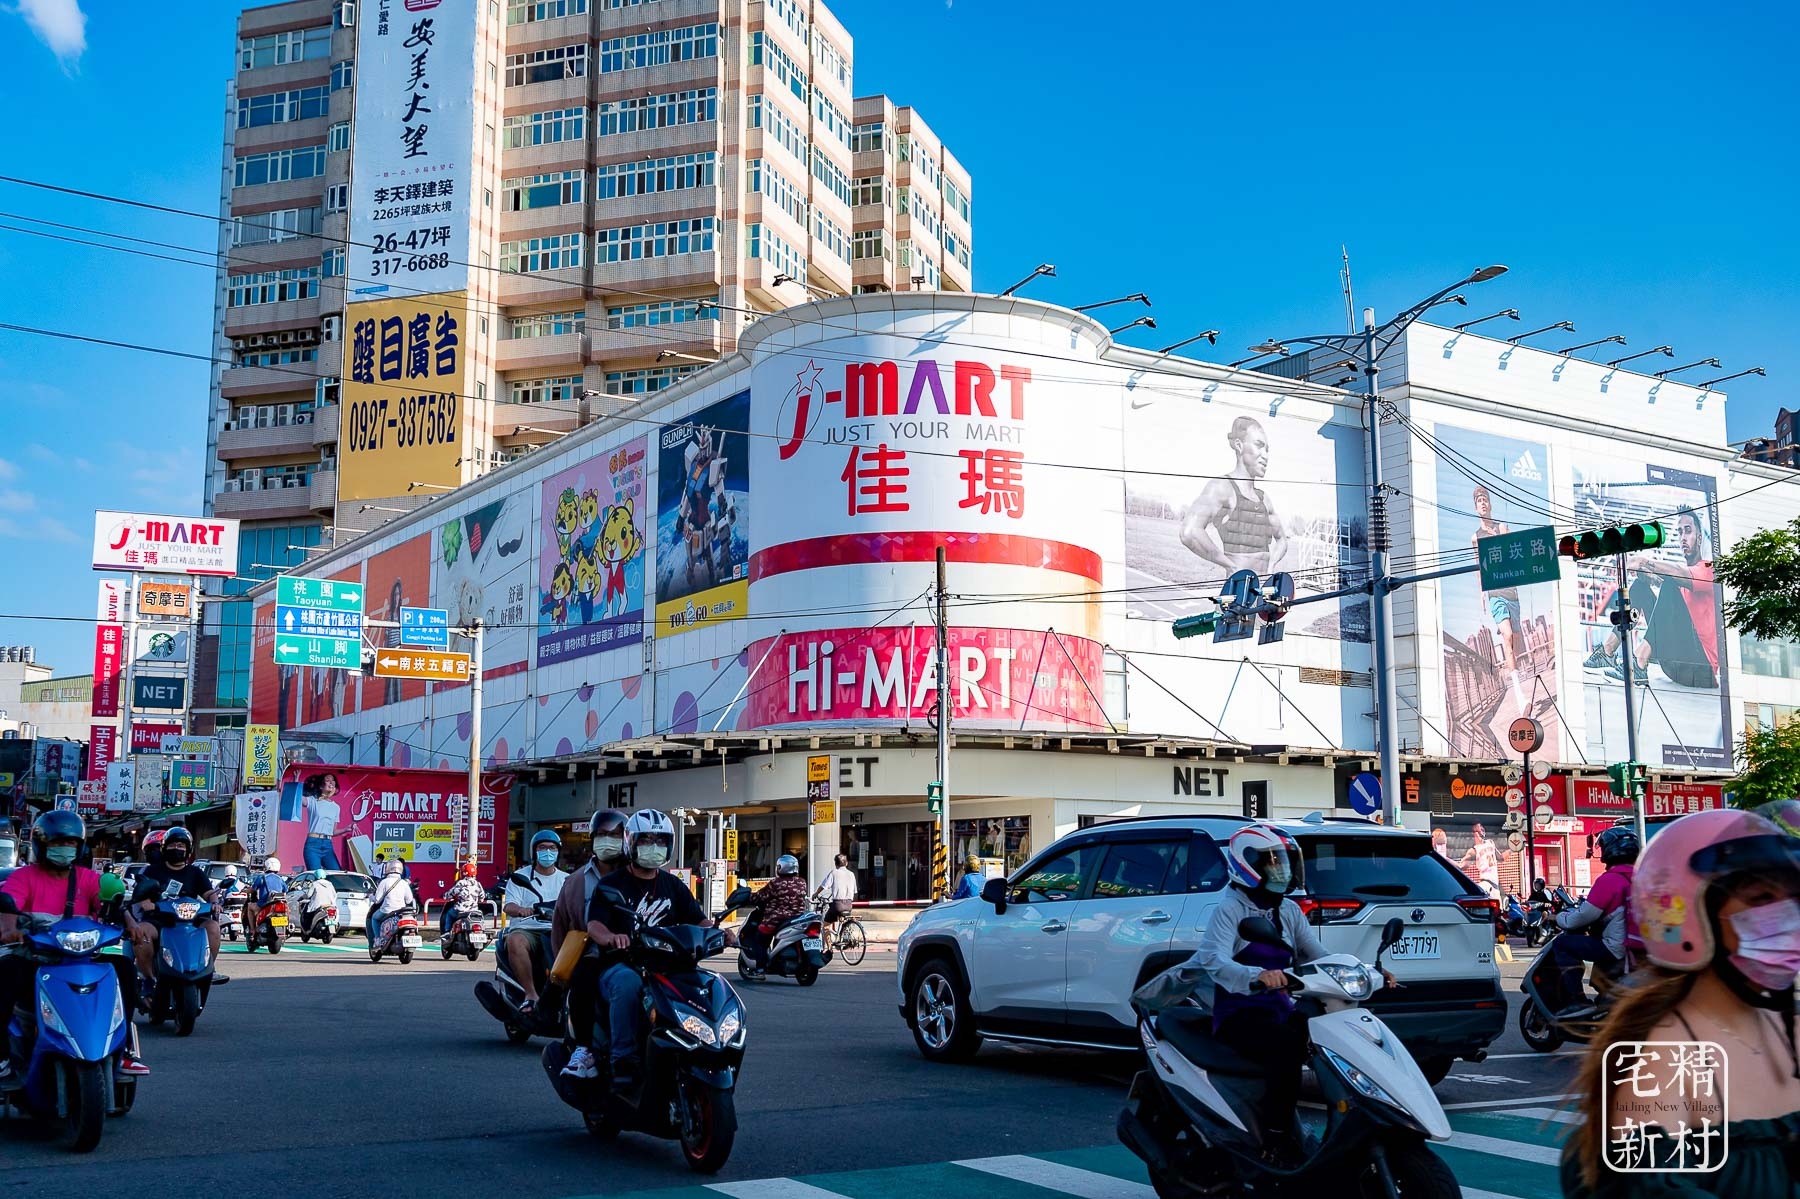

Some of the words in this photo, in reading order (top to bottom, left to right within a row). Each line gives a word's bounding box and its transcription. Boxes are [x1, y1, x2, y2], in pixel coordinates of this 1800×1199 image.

[374, 179, 454, 204] 李天鐸建築
[373, 200, 452, 221] 2265坪望族大境
[372, 226, 451, 255] 26-47坪
[371, 252, 449, 277] 317-6688
[352, 310, 459, 385] 醒目廣告
[349, 392, 456, 453] 0927-337562
[823, 423, 876, 446] JUST
[889, 421, 950, 441] YOUR
[965, 422, 1026, 445] MART
[1511, 467, 1542, 481] adidas
[125, 550, 158, 565] 佳瑪
[137, 542, 162, 551] JUST
[167, 544, 192, 553] YOUR
[197, 546, 224, 555] MART
[1487, 537, 1547, 565] 南崁路
[1492, 567, 1525, 580] Nankan
[293, 579, 334, 598] 桃園
[144, 590, 186, 608] 奇摩吉
[294, 595, 332, 606] Taoyuan
[102, 629, 116, 656] 佳瑪
[309, 655, 347, 665] Shanjiao
[399, 656, 468, 675] 南崁五福宮
[787, 639, 1017, 714] Hi-MART
[142, 685, 178, 700] NET
[1510, 729, 1535, 741] 奇摩吉
[94, 727, 111, 772] Hi-MART
[165, 744, 181, 752] MY
[1173, 766, 1230, 797] NET
[1465, 783, 1508, 798] KIMOGY
[607, 781, 638, 809] NET
[1653, 795, 1670, 814] B1
[1672, 795, 1714, 815] 停車場
[373, 812, 392, 820] JUST
[396, 812, 414, 820] YOUR
[417, 813, 439, 821] MART
[849, 812, 865, 823] NET
[385, 827, 405, 838] NET
